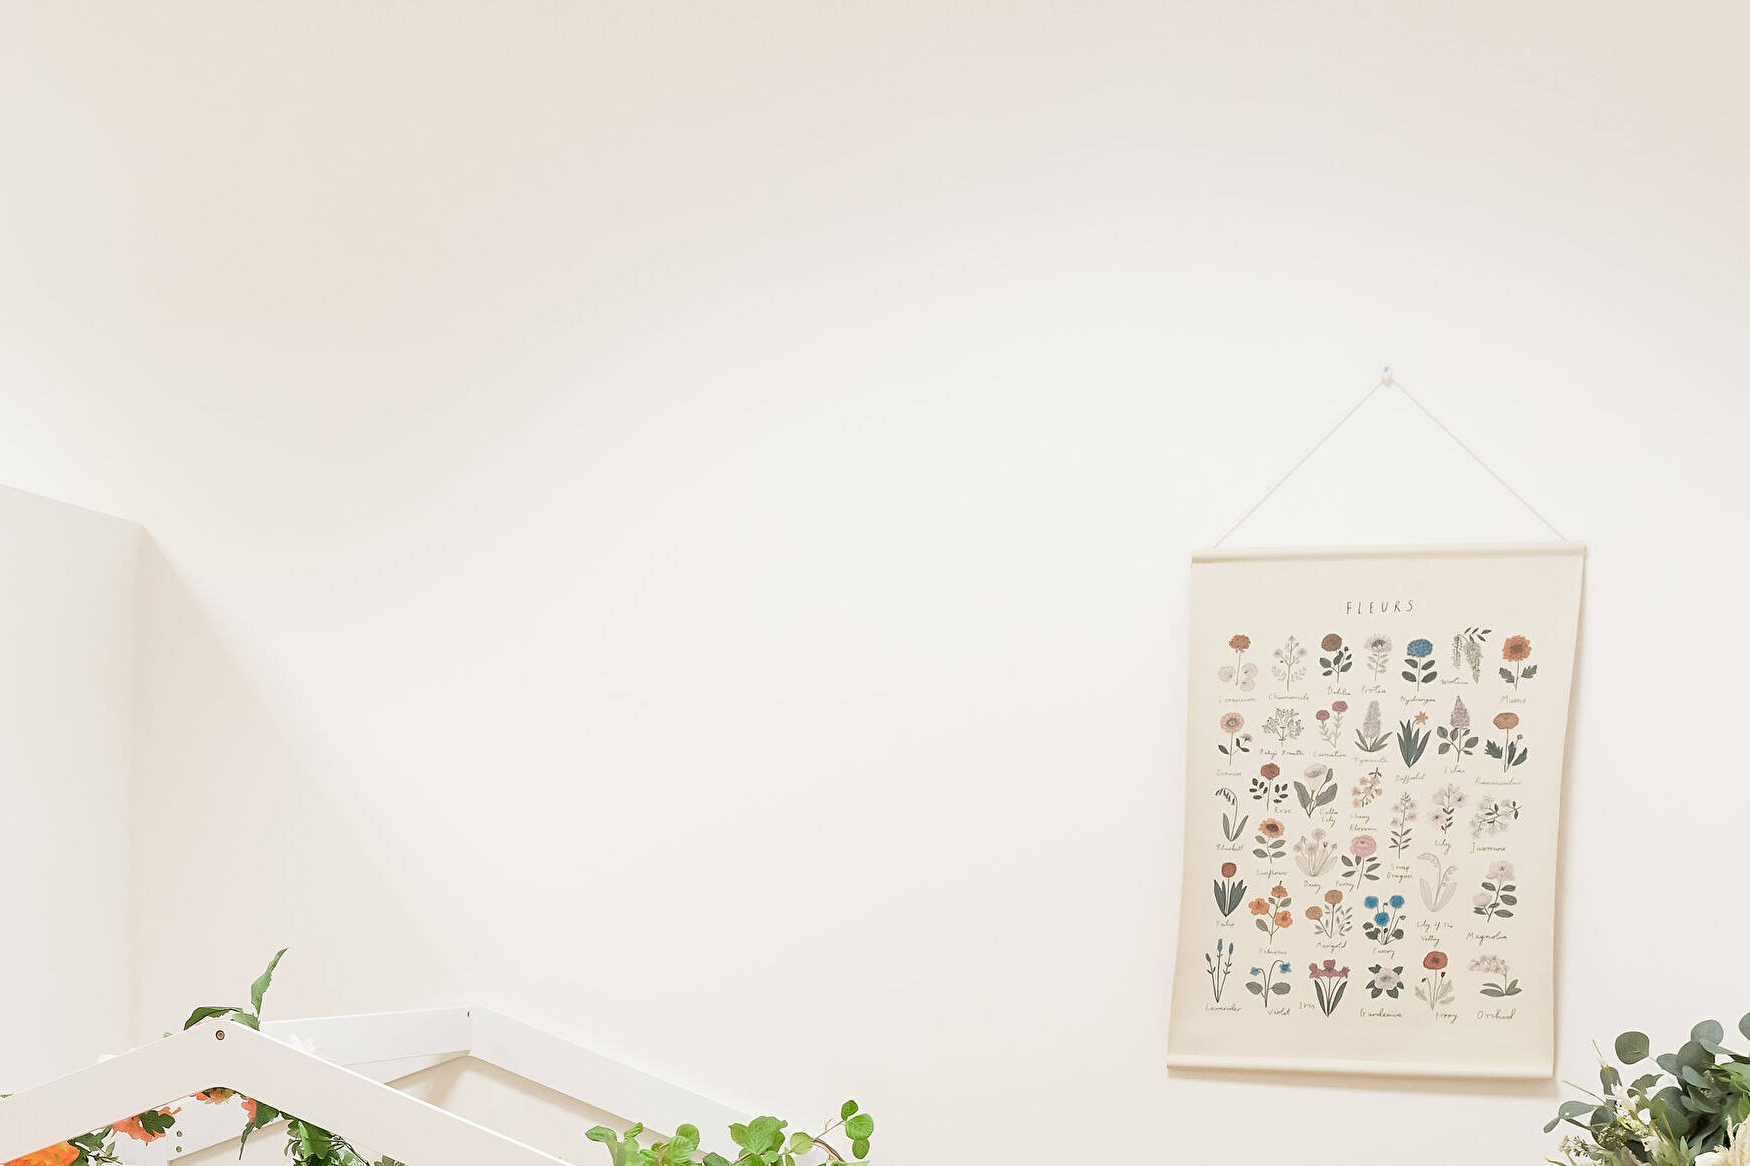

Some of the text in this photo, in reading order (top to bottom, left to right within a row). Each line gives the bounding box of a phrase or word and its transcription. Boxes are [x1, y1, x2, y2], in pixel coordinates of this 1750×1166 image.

[1345, 600, 1415, 615] FLEURS
[1466, 930, 1507, 945] Magnolia
[1205, 1001, 1242, 1012] Lavender
[1267, 1007, 1291, 1016] Violet
[1476, 1008, 1516, 1020] Orchid
